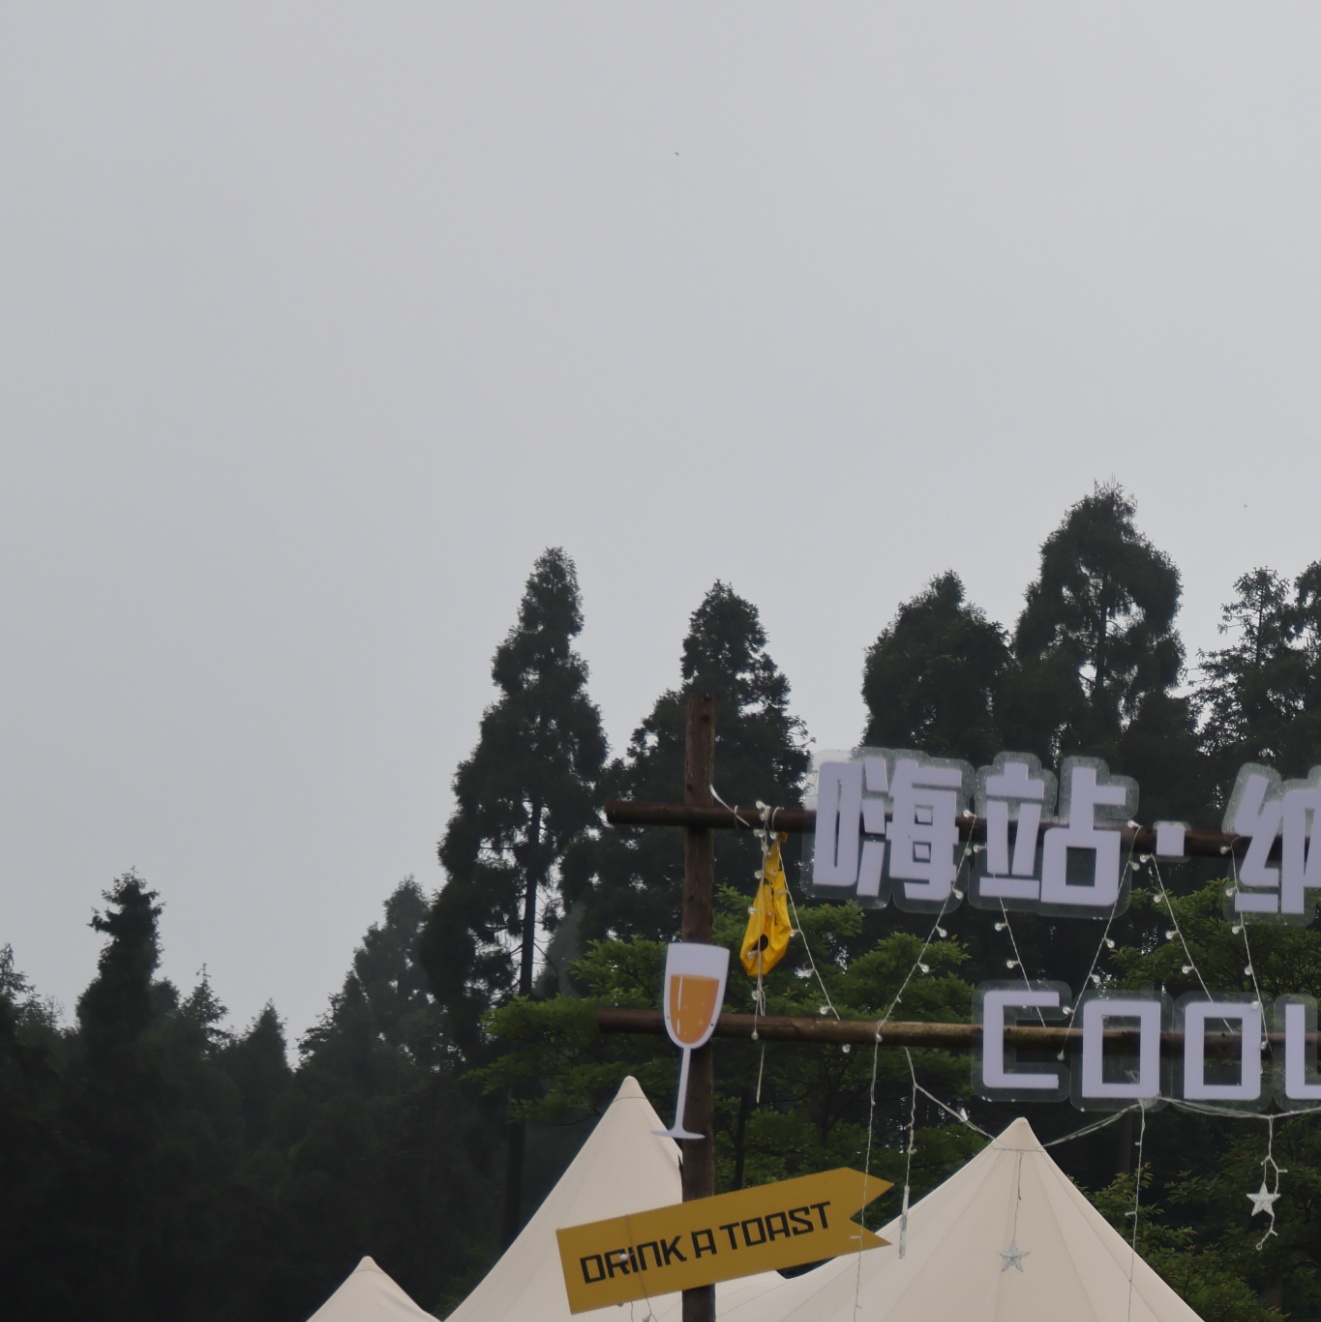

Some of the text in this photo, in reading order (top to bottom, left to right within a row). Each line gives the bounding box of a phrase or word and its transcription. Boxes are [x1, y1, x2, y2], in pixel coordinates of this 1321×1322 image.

[580, 1201, 831, 1284] DRINK A TOAST
